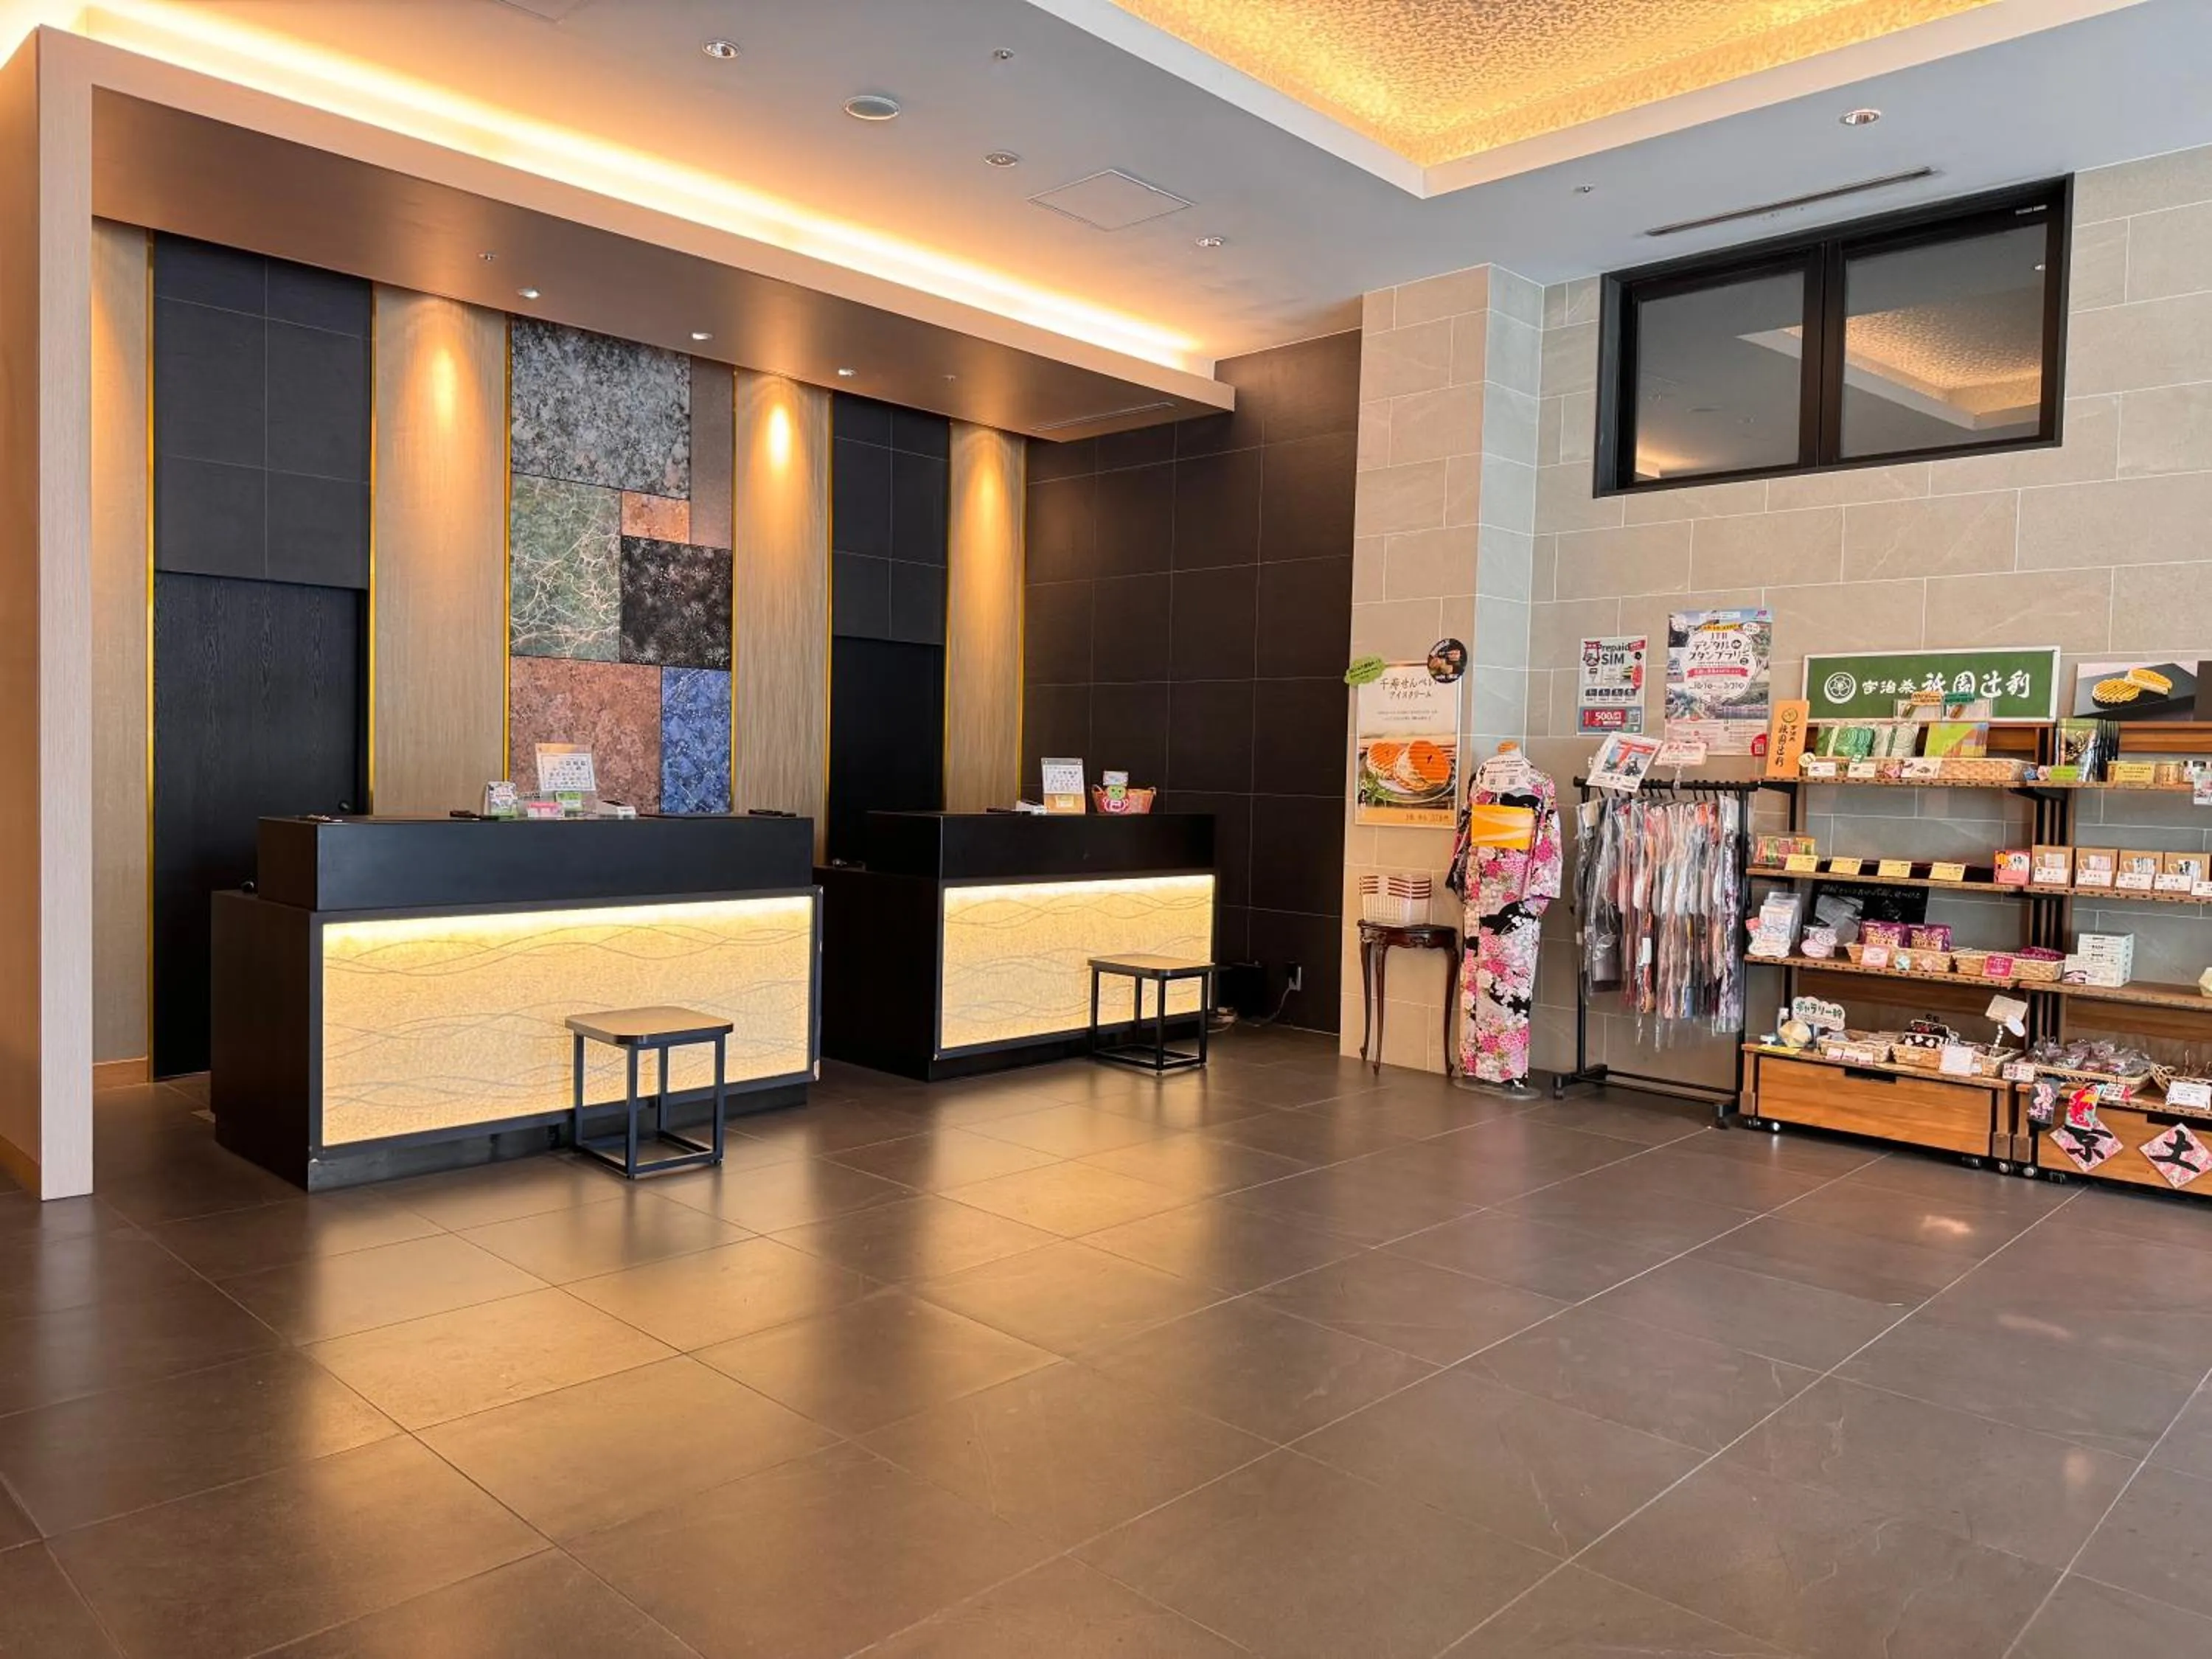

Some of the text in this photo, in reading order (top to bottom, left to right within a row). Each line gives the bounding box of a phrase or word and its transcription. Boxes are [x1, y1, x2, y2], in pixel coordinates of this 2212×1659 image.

[1601, 653, 1624, 666] SIM
[1862, 678, 1917, 695] 宇治茶
